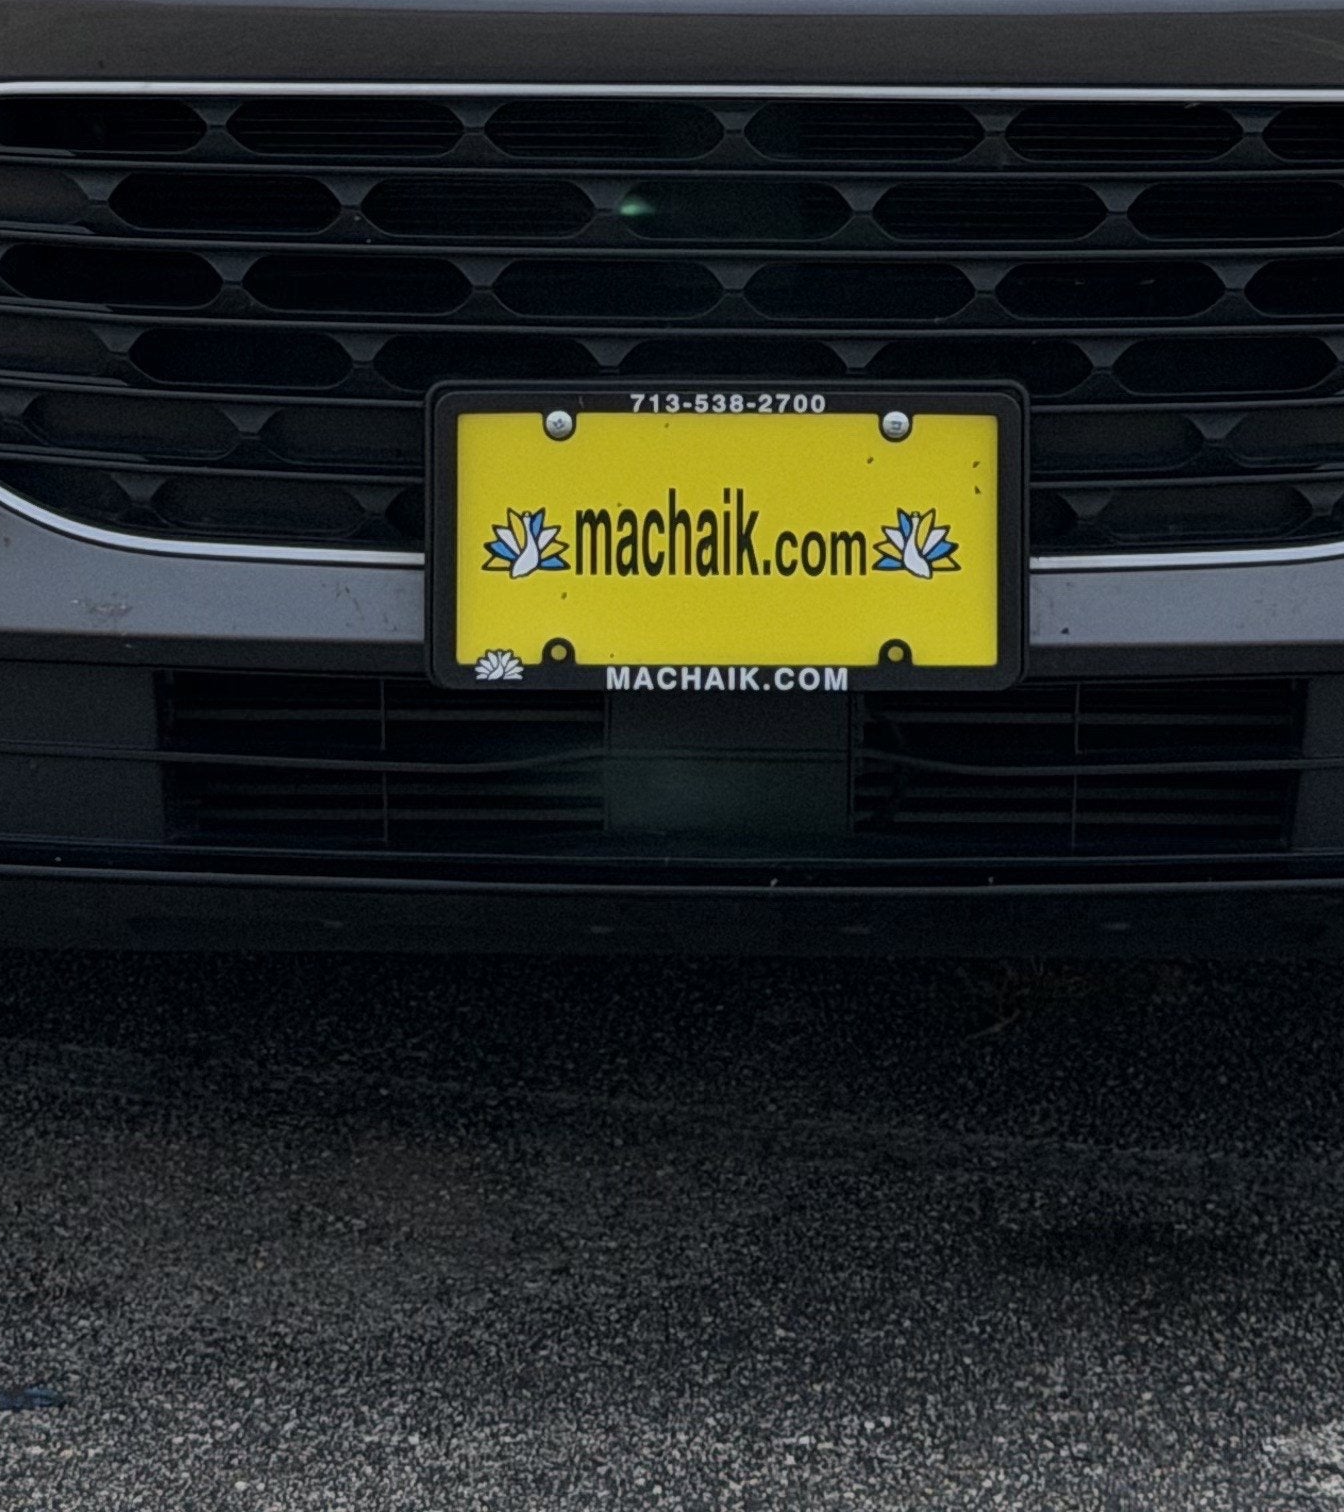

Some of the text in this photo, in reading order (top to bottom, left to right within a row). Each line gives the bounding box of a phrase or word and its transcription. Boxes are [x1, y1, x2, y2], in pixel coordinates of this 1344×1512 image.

[630, 393, 826, 414] 713-538-2700
[575, 487, 868, 576] machaik.com
[606, 666, 849, 691] MACHAIK.COM
